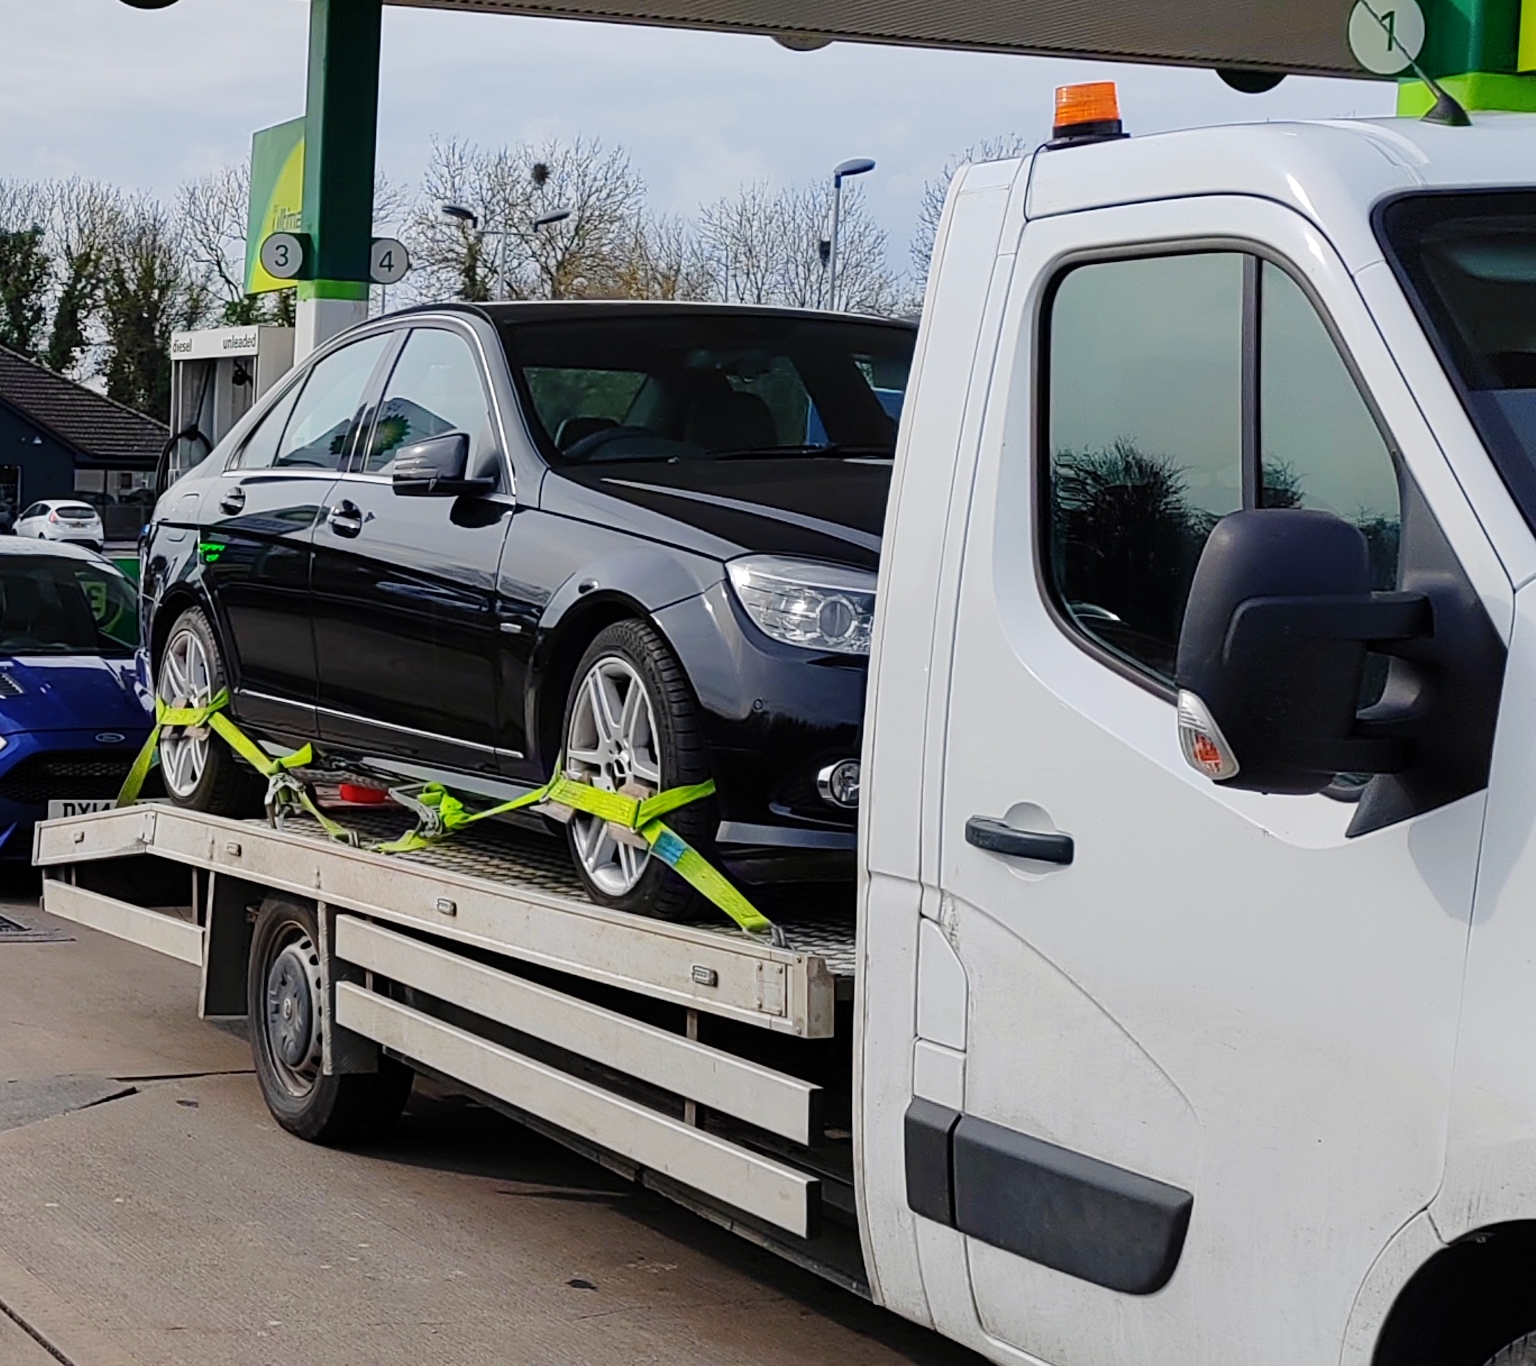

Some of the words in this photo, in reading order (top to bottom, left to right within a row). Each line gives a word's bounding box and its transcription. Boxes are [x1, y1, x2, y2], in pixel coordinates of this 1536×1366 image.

[1380, 9, 1395, 52] 1
[273, 243, 289, 268] 3
[378, 249, 395, 273] 4
[172, 338, 193, 354] diesel
[221, 333, 257, 351] unleaded
